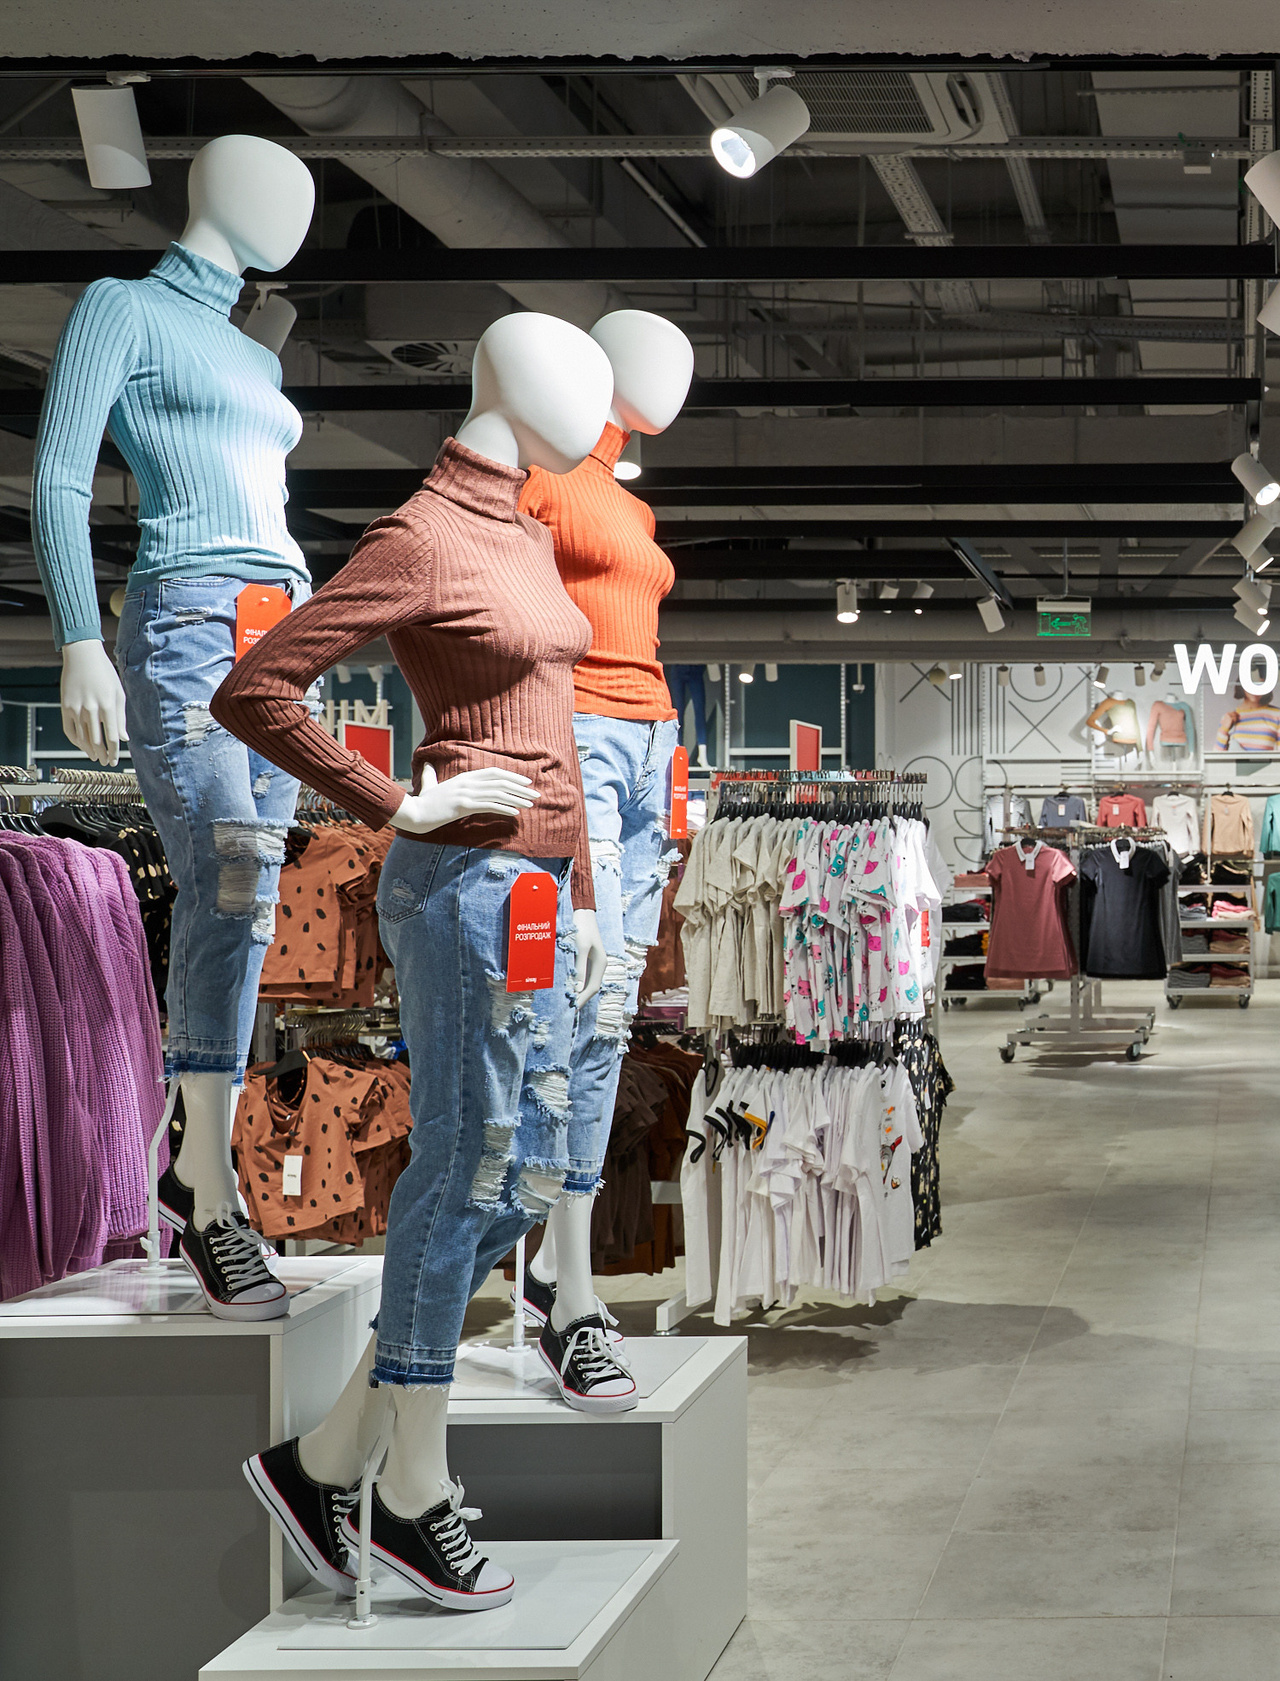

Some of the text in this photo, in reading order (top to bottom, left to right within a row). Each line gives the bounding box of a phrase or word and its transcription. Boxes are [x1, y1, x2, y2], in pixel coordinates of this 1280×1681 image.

[244, 628, 268, 637] ФІНАЛ
[516, 921, 551, 931] ФІНАЛЬНИЙ
[515, 931, 552, 941] РОЗПРОДАЖ
